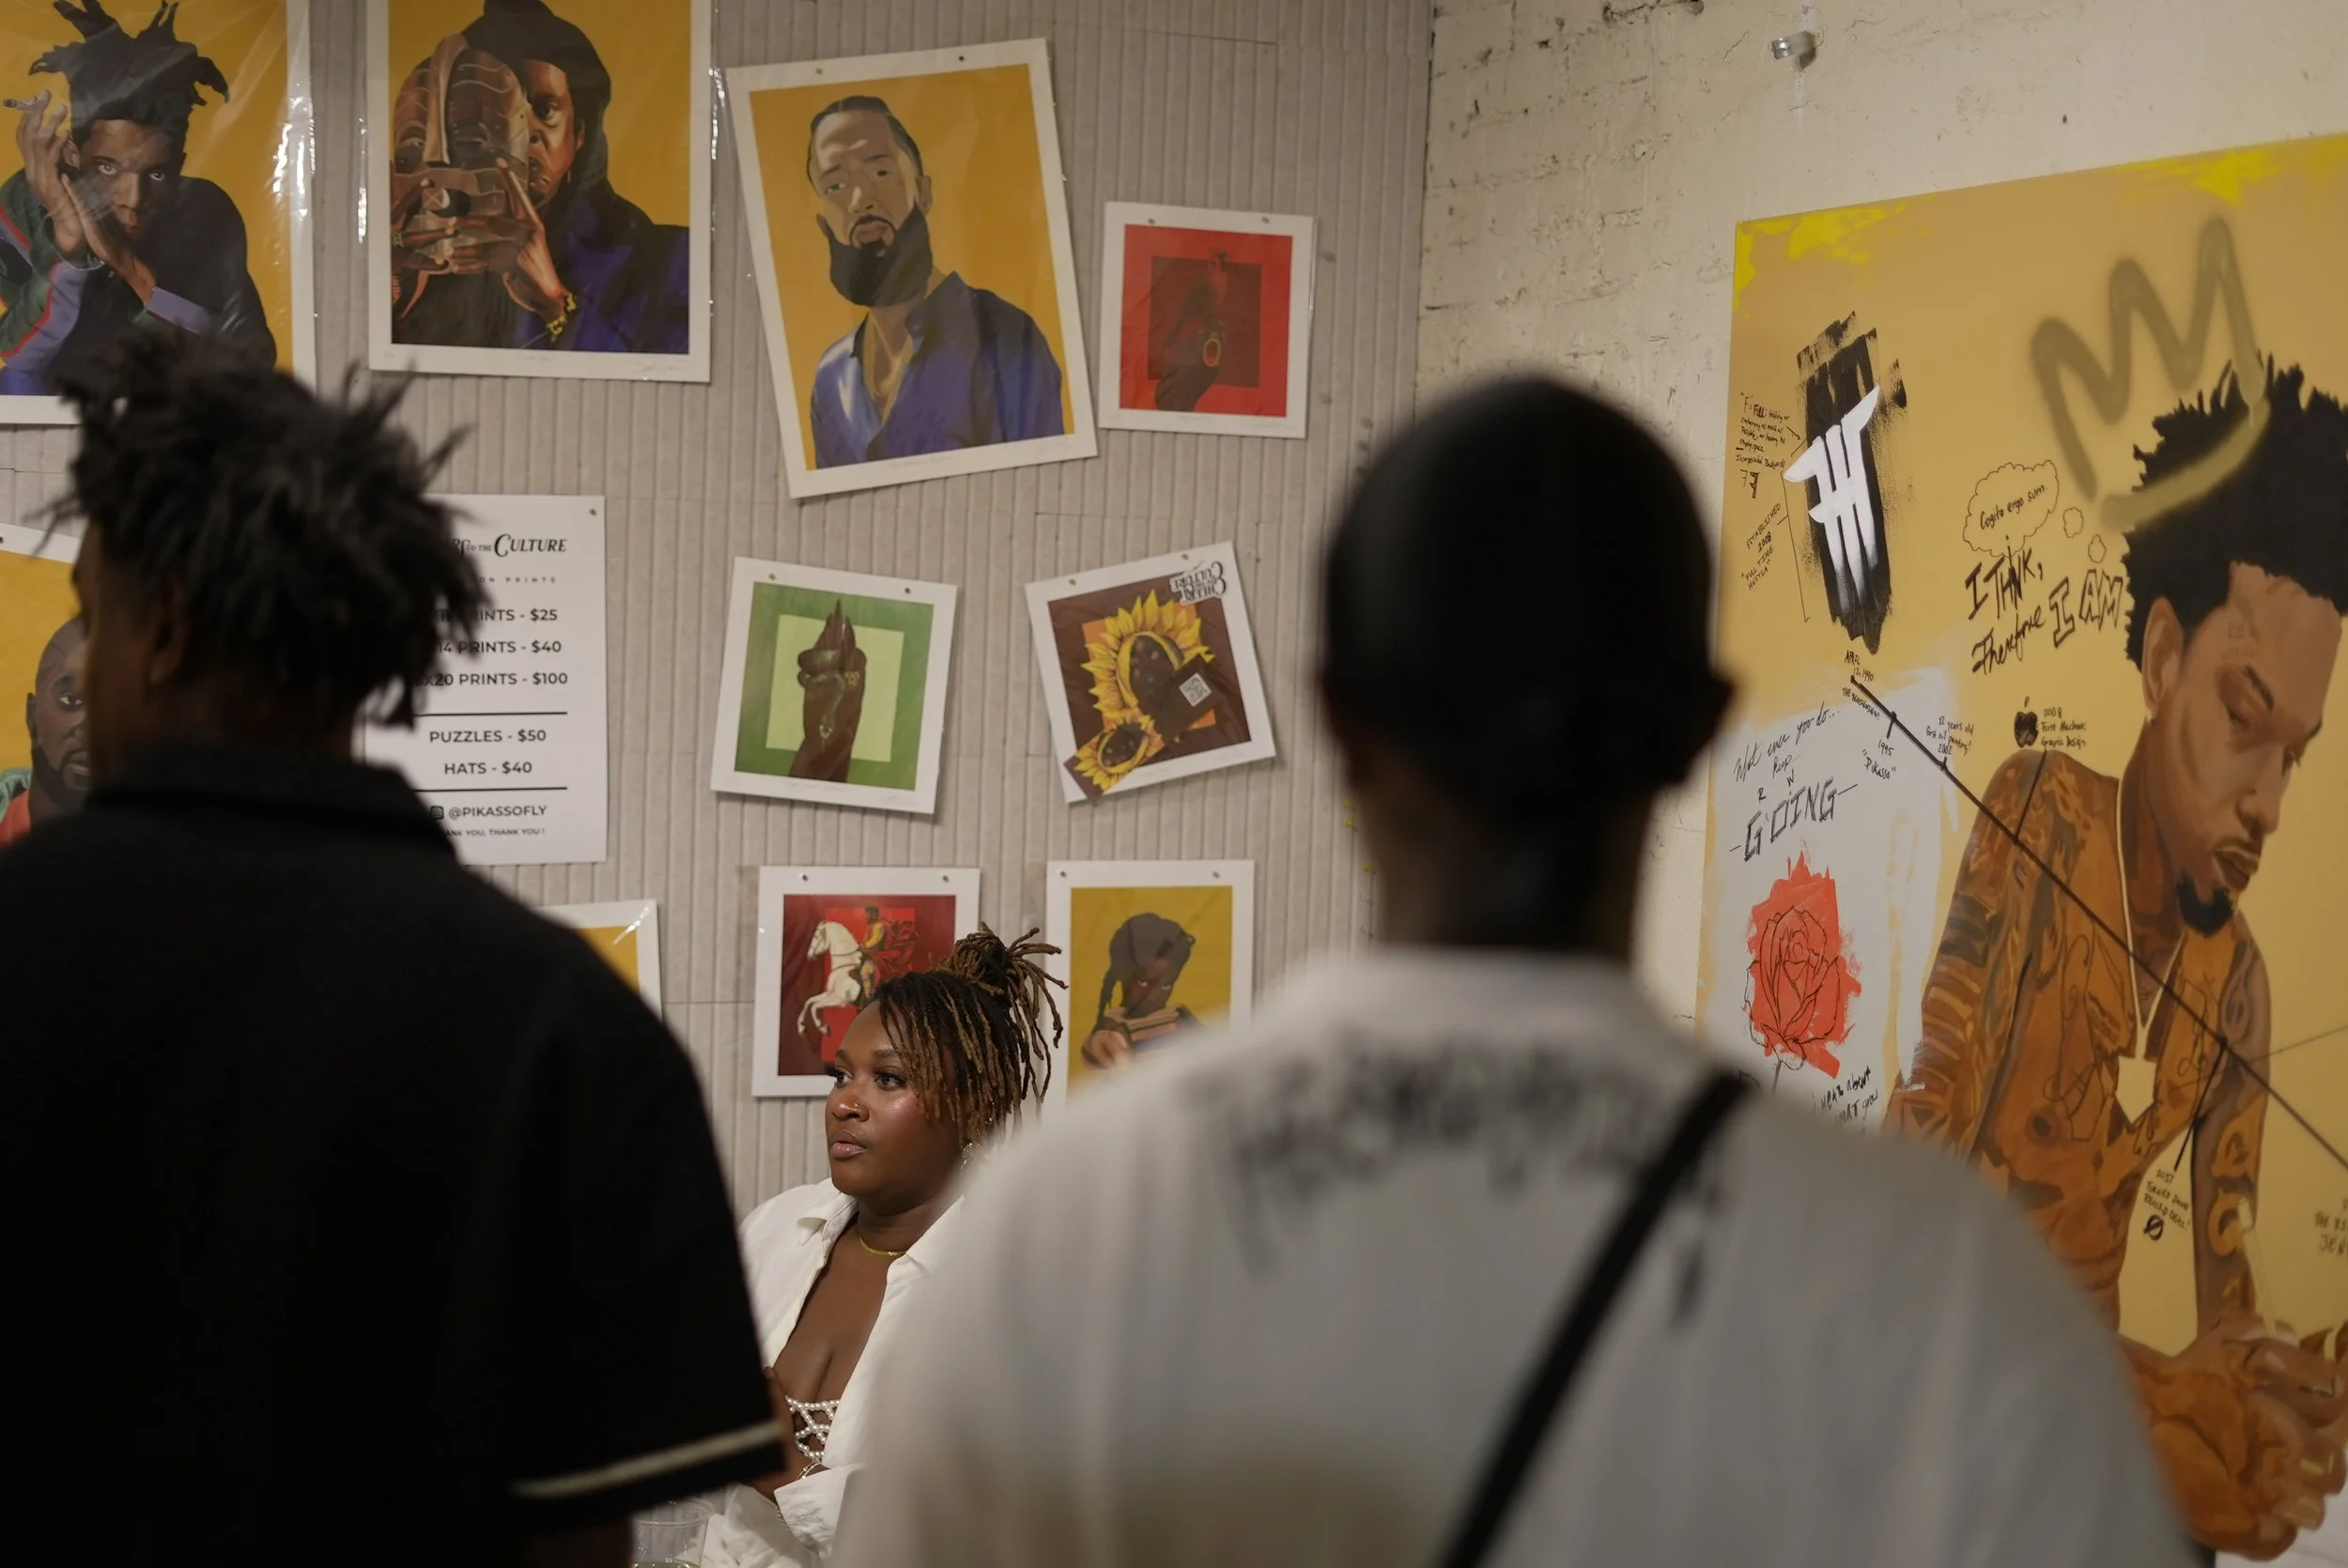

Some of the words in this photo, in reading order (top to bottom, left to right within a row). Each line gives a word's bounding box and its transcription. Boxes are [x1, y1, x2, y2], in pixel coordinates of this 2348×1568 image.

[1980, 508, 2004, 530] Cogito
[2006, 496, 2025, 515] ergo
[494, 532, 568, 558] CULTURE
[2078, 567, 2124, 632] AM
[531, 607, 558, 623] $25
[532, 639, 563, 654] $40
[459, 672, 517, 685] PRINTS
[533, 671, 568, 685] $100
[429, 730, 502, 743] PUZZLES
[517, 729, 547, 743] $50
[1877, 739, 1894, 757] 1995
[443, 761, 487, 775] HATS
[502, 761, 533, 775] $40
[448, 806, 548, 821] @PIKASSOFLY
